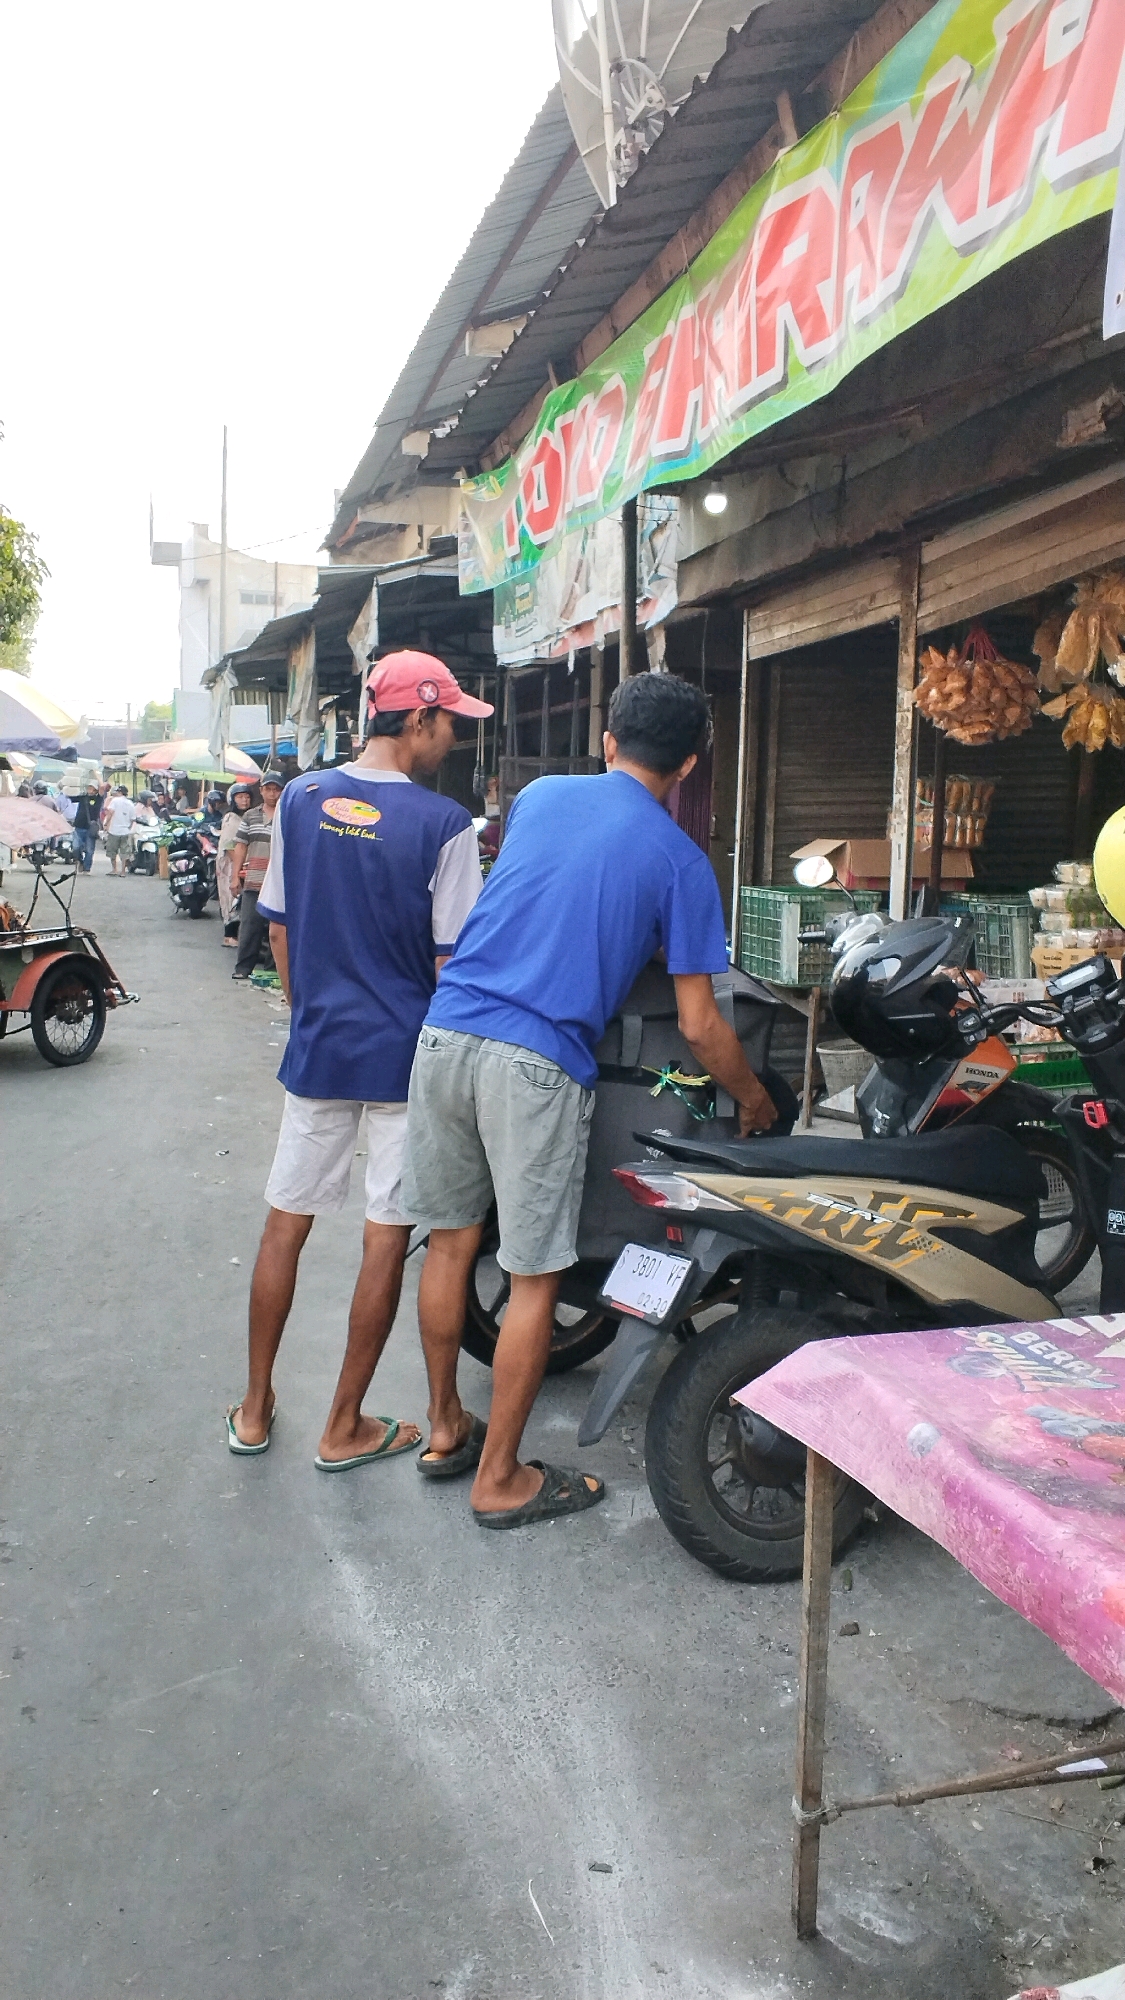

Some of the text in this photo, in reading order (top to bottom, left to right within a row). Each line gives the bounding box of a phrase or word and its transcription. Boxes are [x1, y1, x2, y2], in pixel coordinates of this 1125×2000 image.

[965, 1066, 1000, 1079] HONDA
[632, 1253, 663, 1280] 3801
[1009, 1330, 1117, 1379] BERRY
